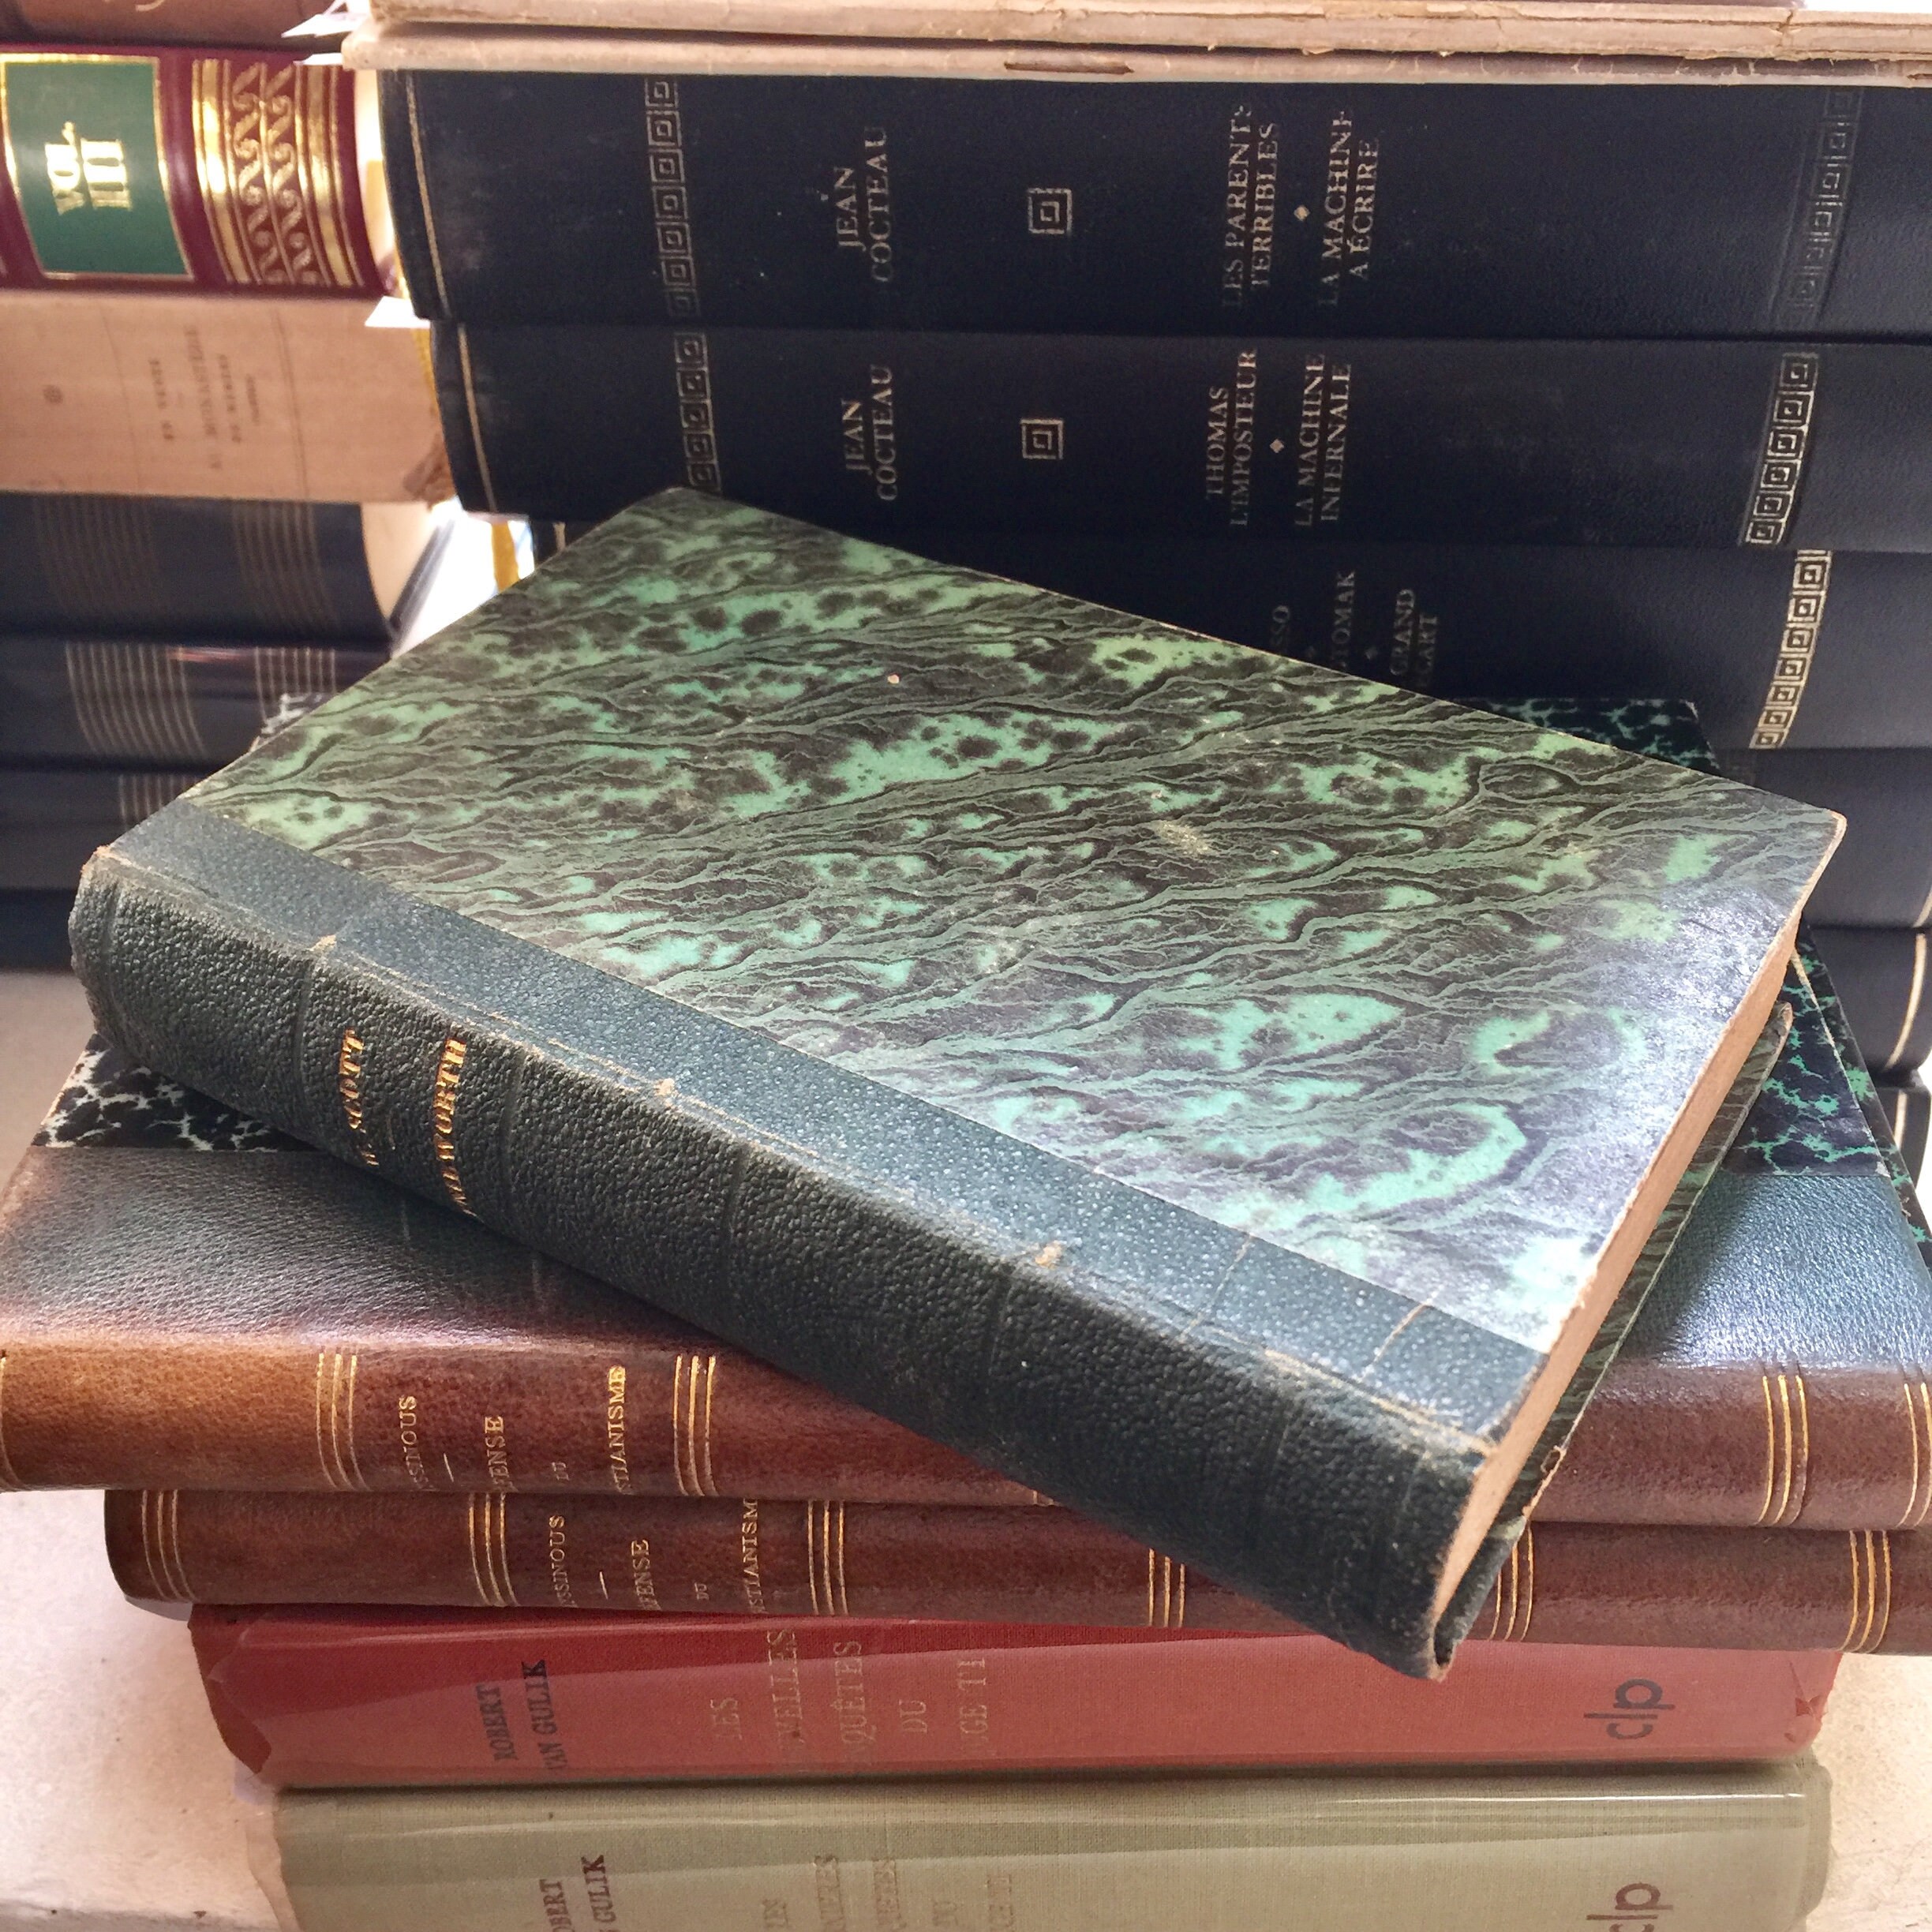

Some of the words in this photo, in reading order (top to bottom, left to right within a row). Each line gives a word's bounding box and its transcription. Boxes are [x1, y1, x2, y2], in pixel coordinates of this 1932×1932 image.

[833, 166, 866, 252] JEAN
[864, 125, 894, 283] COCTEAU
[1225, 105, 1252, 247] PARENTS
[1250, 122, 1279, 290] TERRIBLES
[1322, 110, 1352, 260] MACHINE
[1347, 137, 1379, 253] ÉCRIRE
[1222, 259, 1244, 308] LES
[1317, 272, 1340, 305] LA
[841, 399, 872, 474] JEAN
[871, 364, 897, 500] COCTEAU
[1205, 386, 1228, 499] THOMAS
[1230, 349, 1256, 526] L'IMPOSTEUR
[1297, 353, 1325, 485] MACHINE
[1321, 363, 1351, 521] INFERNALE
[1294, 497, 1314, 526] LA
[608, 1366, 631, 1495] STIANISME
[742, 1498, 766, 1614] STIANISM
[476, 1685, 519, 1761] ROBERT
[521, 1660, 557, 1735] GULIK
[710, 1697, 743, 1741] LES
[829, 1641, 878, 1757] QUÊTES
[898, 1699, 928, 1734] DU
[956, 1657, 987, 1690] TI
[1583, 1678, 1675, 1739] clp
[581, 1855, 616, 1923] GULIK
